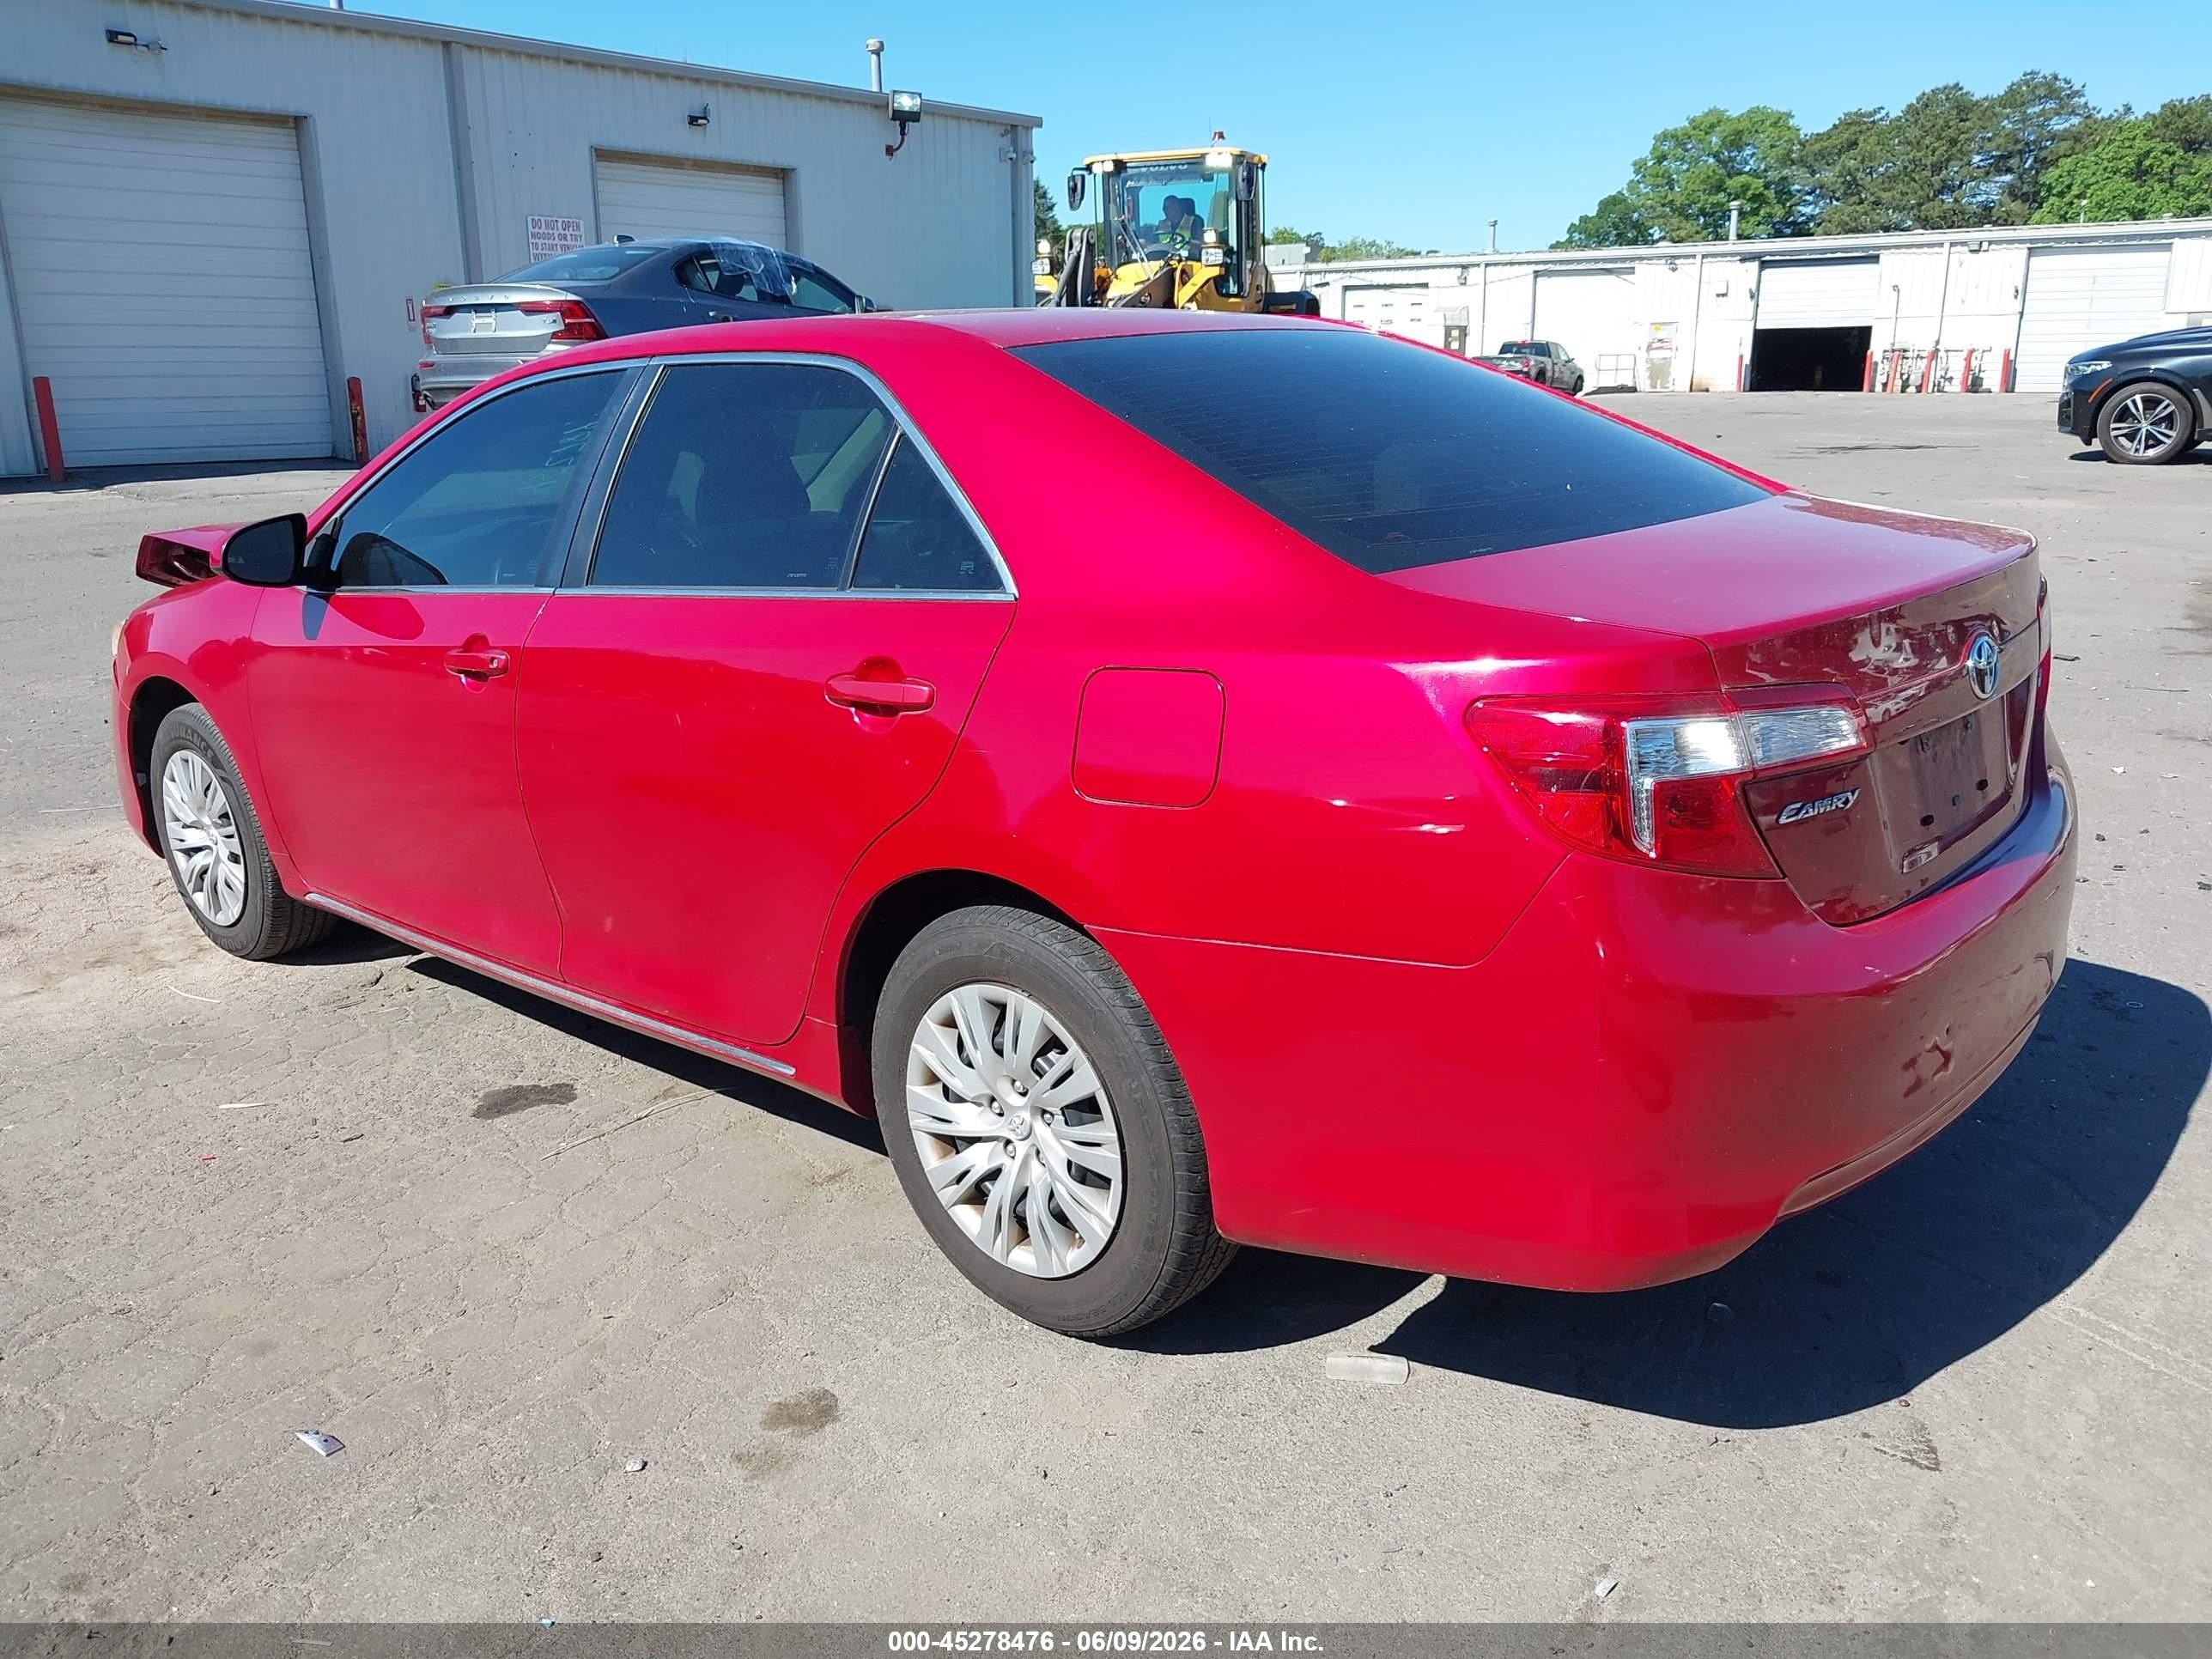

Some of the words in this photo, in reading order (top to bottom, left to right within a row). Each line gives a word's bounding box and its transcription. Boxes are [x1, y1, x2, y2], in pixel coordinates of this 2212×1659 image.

[532, 218, 543, 229] DO
[544, 219, 559, 231] NOT
[562, 220, 581, 233] OPEN
[531, 231, 556, 241] HOODS
[557, 233, 568, 242] OR
[569, 234, 583, 243] TRY
[531, 242, 539, 251] TO
[540, 242, 558, 252] START
[1777, 788, 1861, 824] CAMRY
